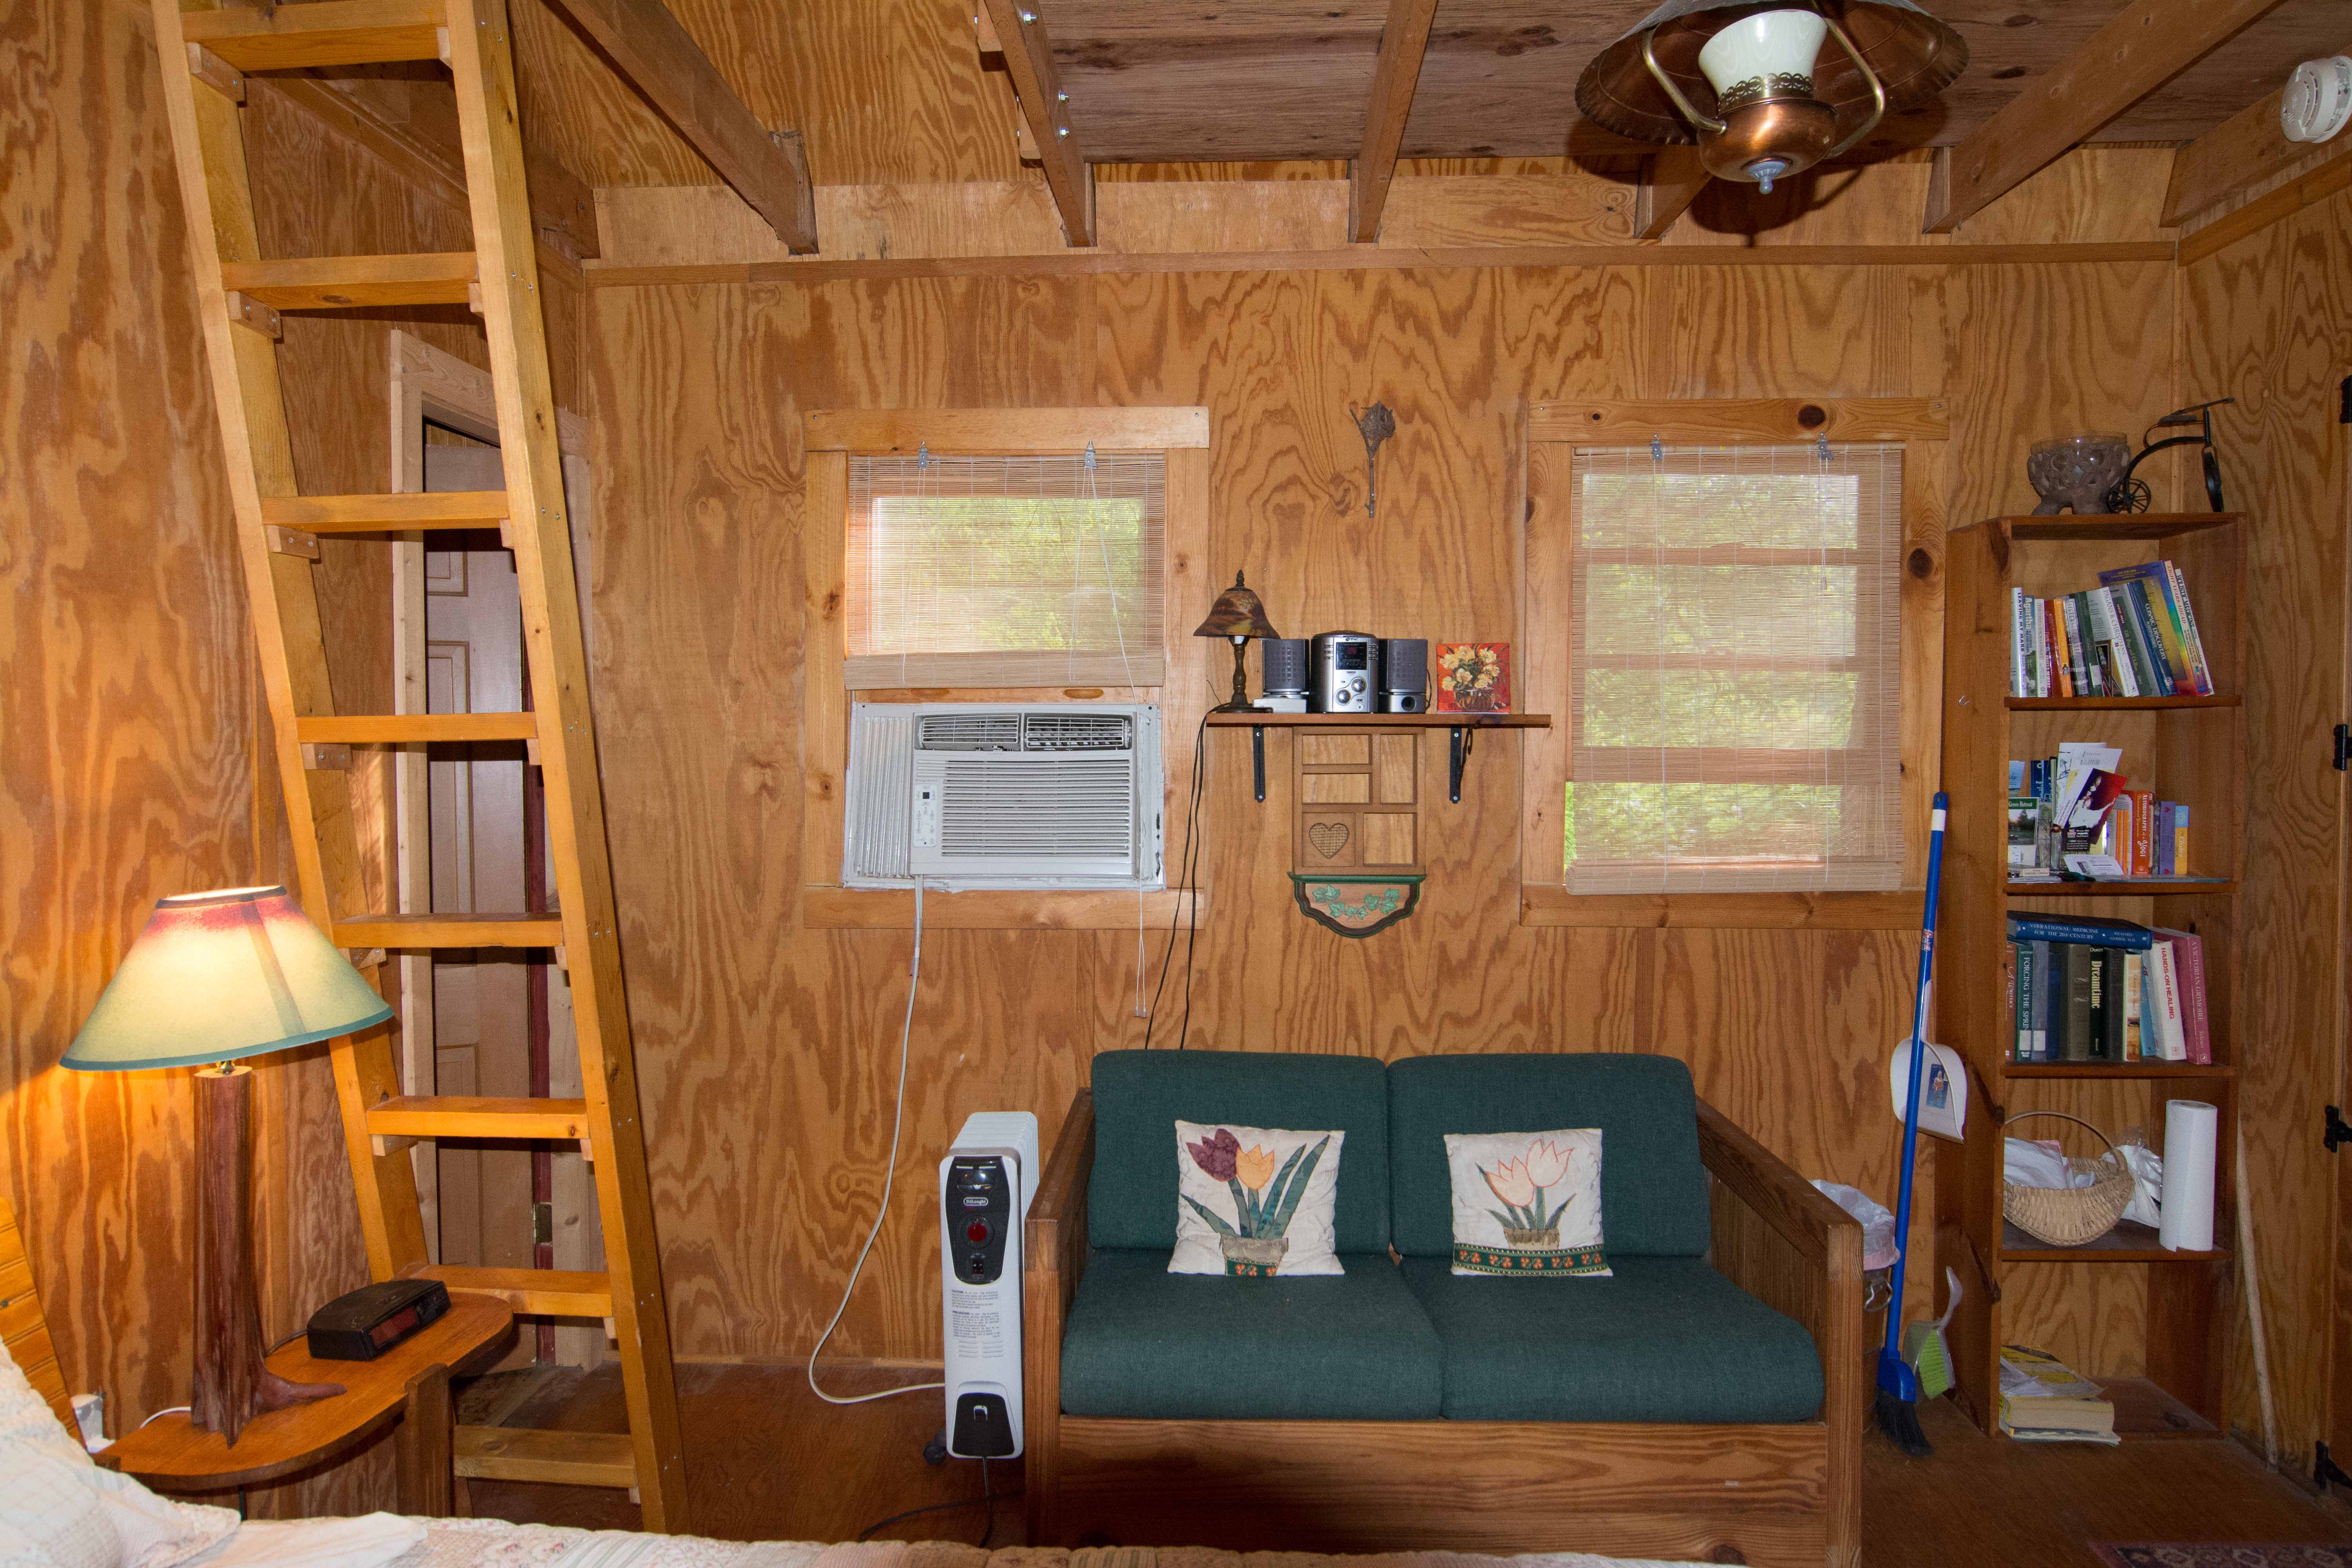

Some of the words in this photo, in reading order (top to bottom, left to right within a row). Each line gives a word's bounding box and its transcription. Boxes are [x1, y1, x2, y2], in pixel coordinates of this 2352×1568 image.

[2024, 597, 2033, 630] Agartha
[2067, 603, 2075, 625] SISTERS
[2103, 590, 2112, 613] PAGANS
[2172, 584, 2180, 603] YEARS
[2178, 605, 2186, 624] AHEAD
[2176, 575, 2186, 600] HOLISTIC
[2182, 601, 2194, 628] MEDICINE
[2019, 622, 2024, 631] MY
[2145, 604, 2156, 626] COSMIC
[2152, 628, 2167, 660] DISCOVERY
[2030, 923, 2070, 931] VIBRATIONAL
[2091, 961, 2102, 1009] Dreamtime
[2161, 947, 2171, 986] HANDS-ON
[2166, 987, 2174, 1019] HEALING
